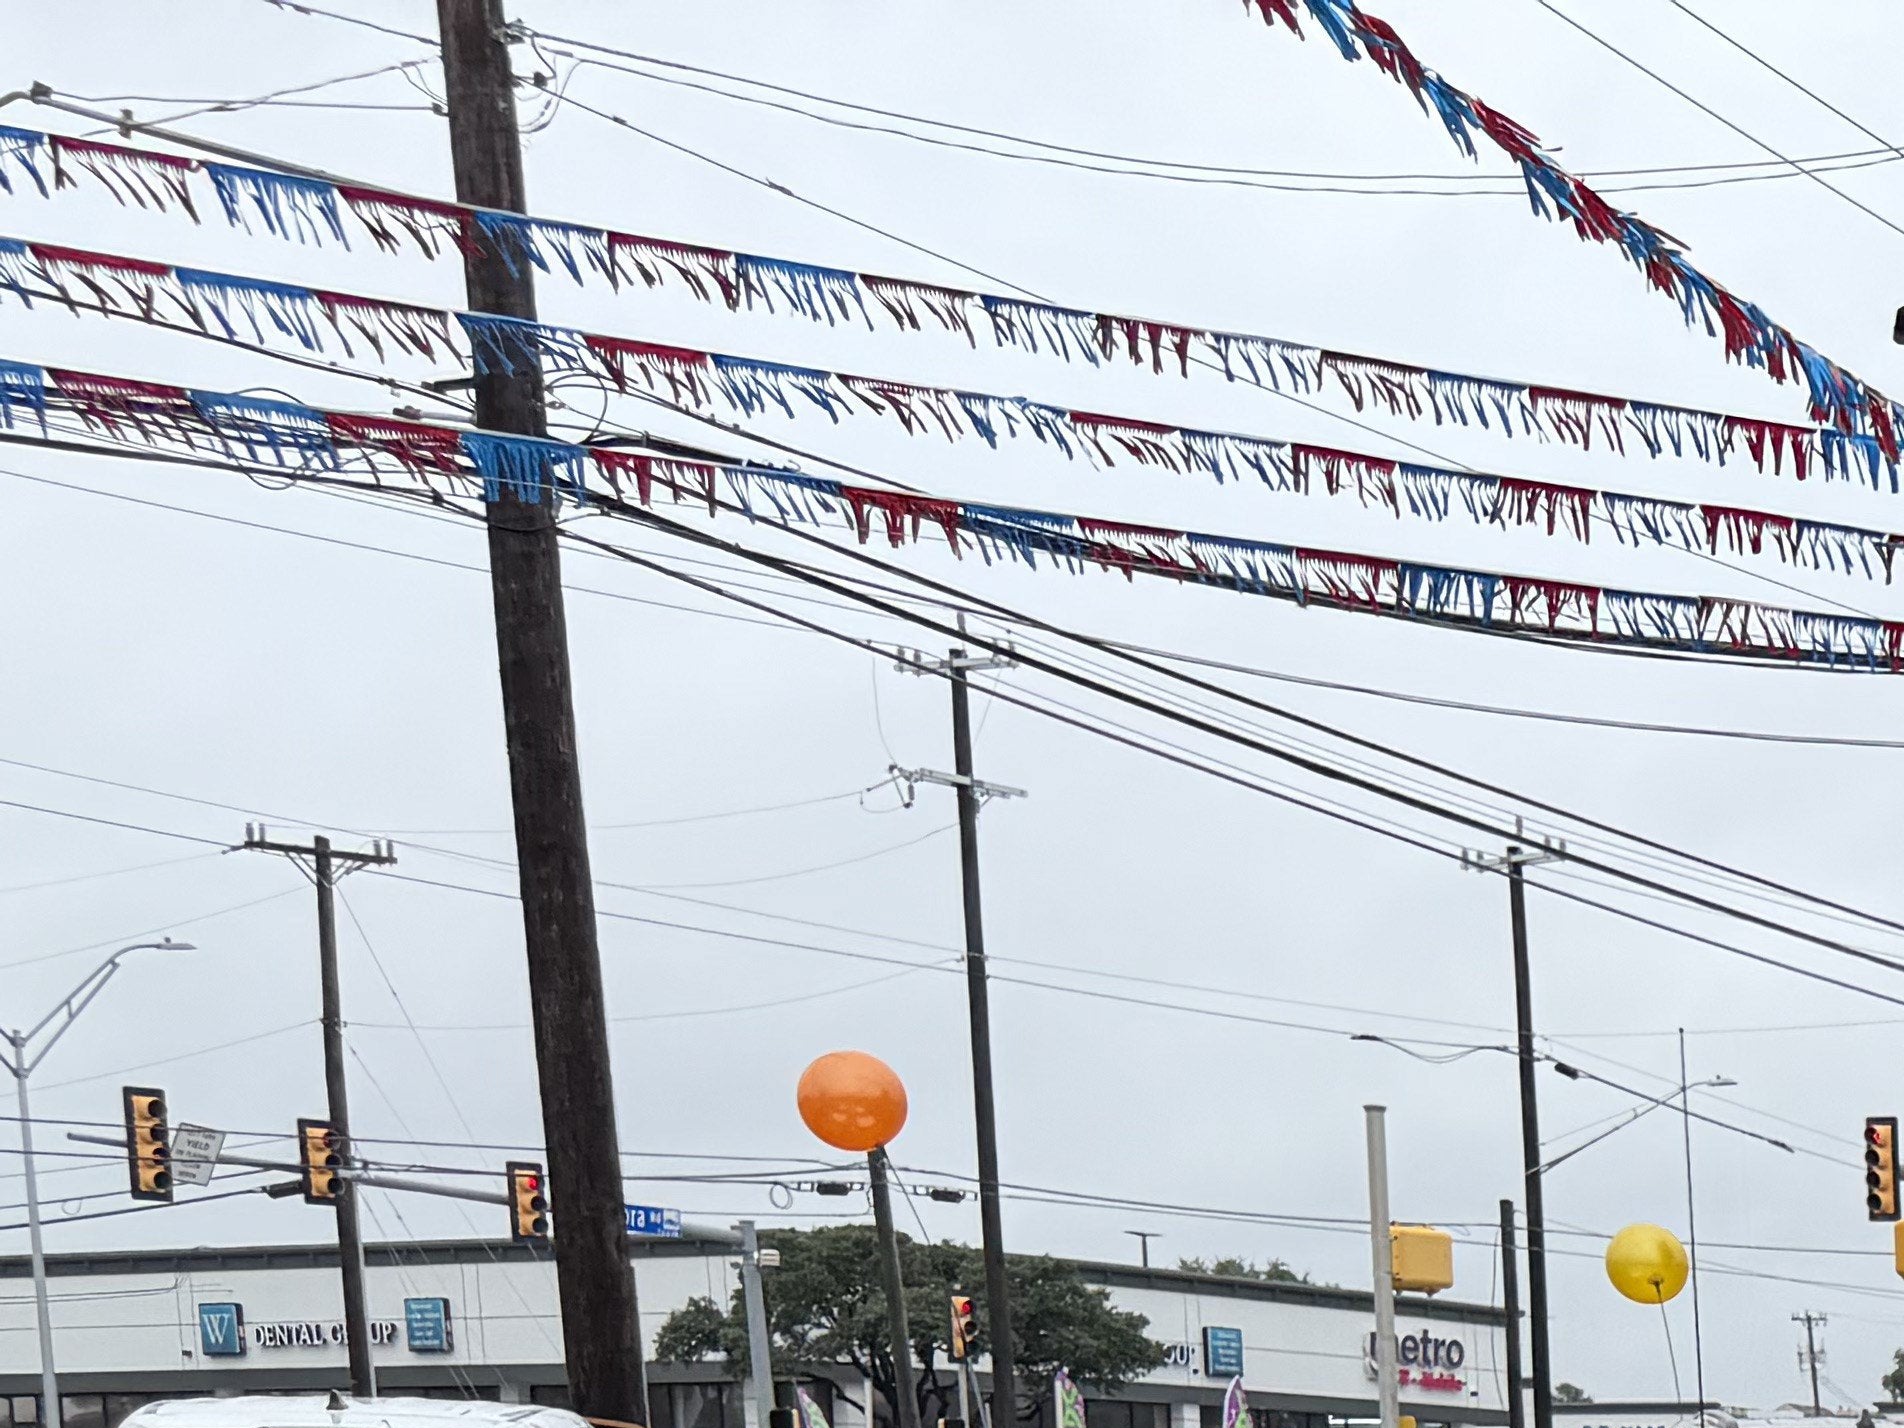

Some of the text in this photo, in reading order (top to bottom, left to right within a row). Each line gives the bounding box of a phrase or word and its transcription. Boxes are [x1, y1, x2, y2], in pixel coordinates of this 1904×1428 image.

[202, 1314, 230, 1345] W
[254, 1322, 325, 1346] DENTAL
[331, 1321, 393, 1345] GUP
